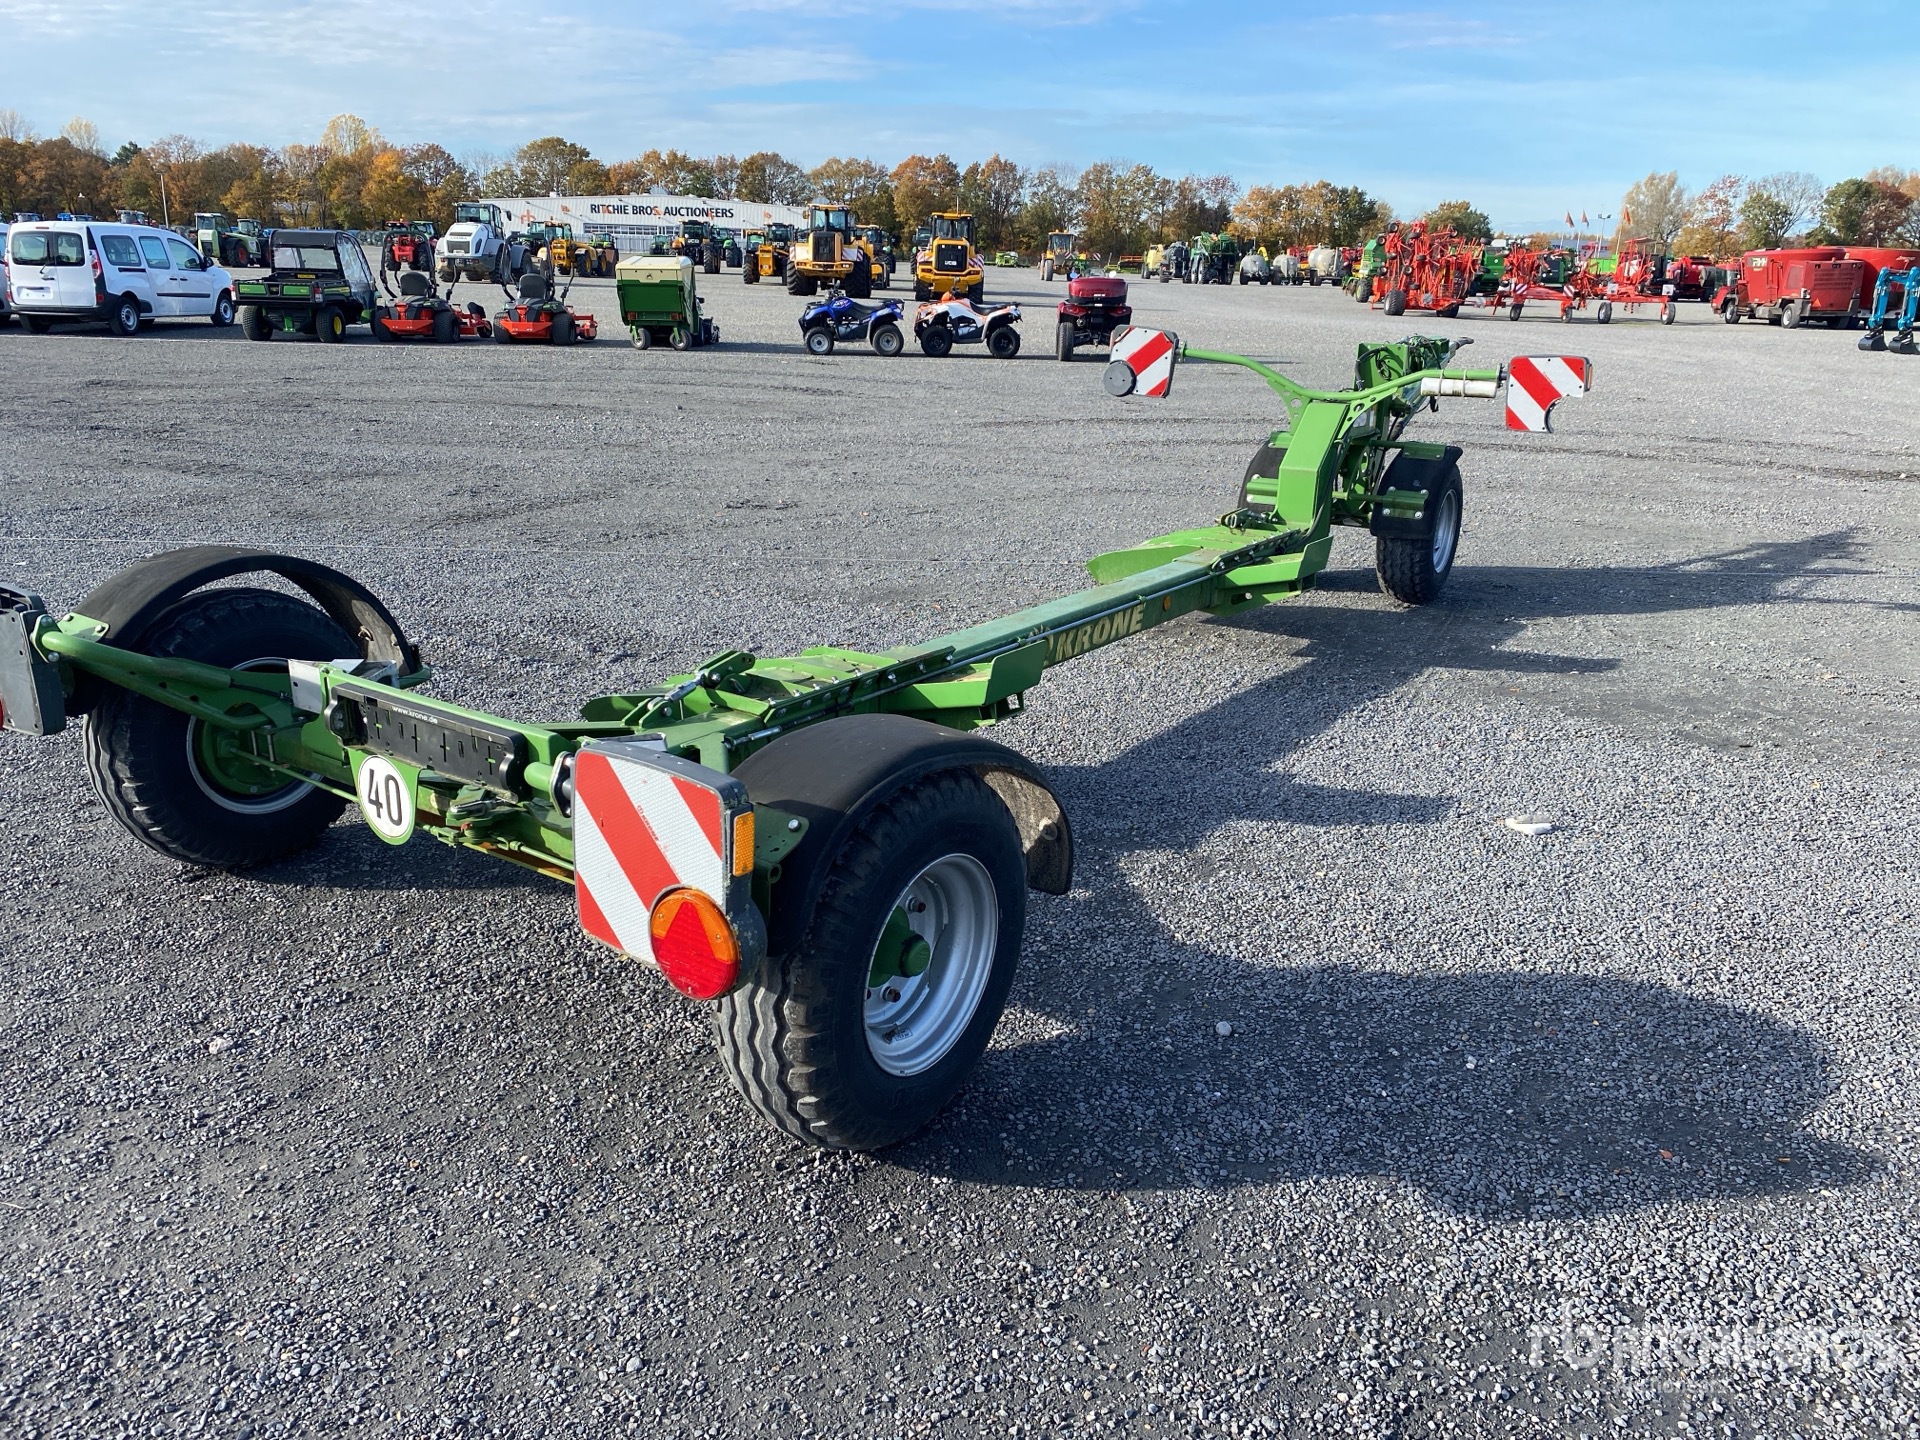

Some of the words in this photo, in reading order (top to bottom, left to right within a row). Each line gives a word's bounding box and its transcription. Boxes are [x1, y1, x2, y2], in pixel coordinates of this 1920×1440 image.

[590, 204, 629, 215] RITCHIE
[663, 206, 734, 218] AUCTIONEERS
[1055, 604, 1145, 662] KRONE
[391, 705, 438, 725] www.krone.de
[368, 768, 403, 831] 40
